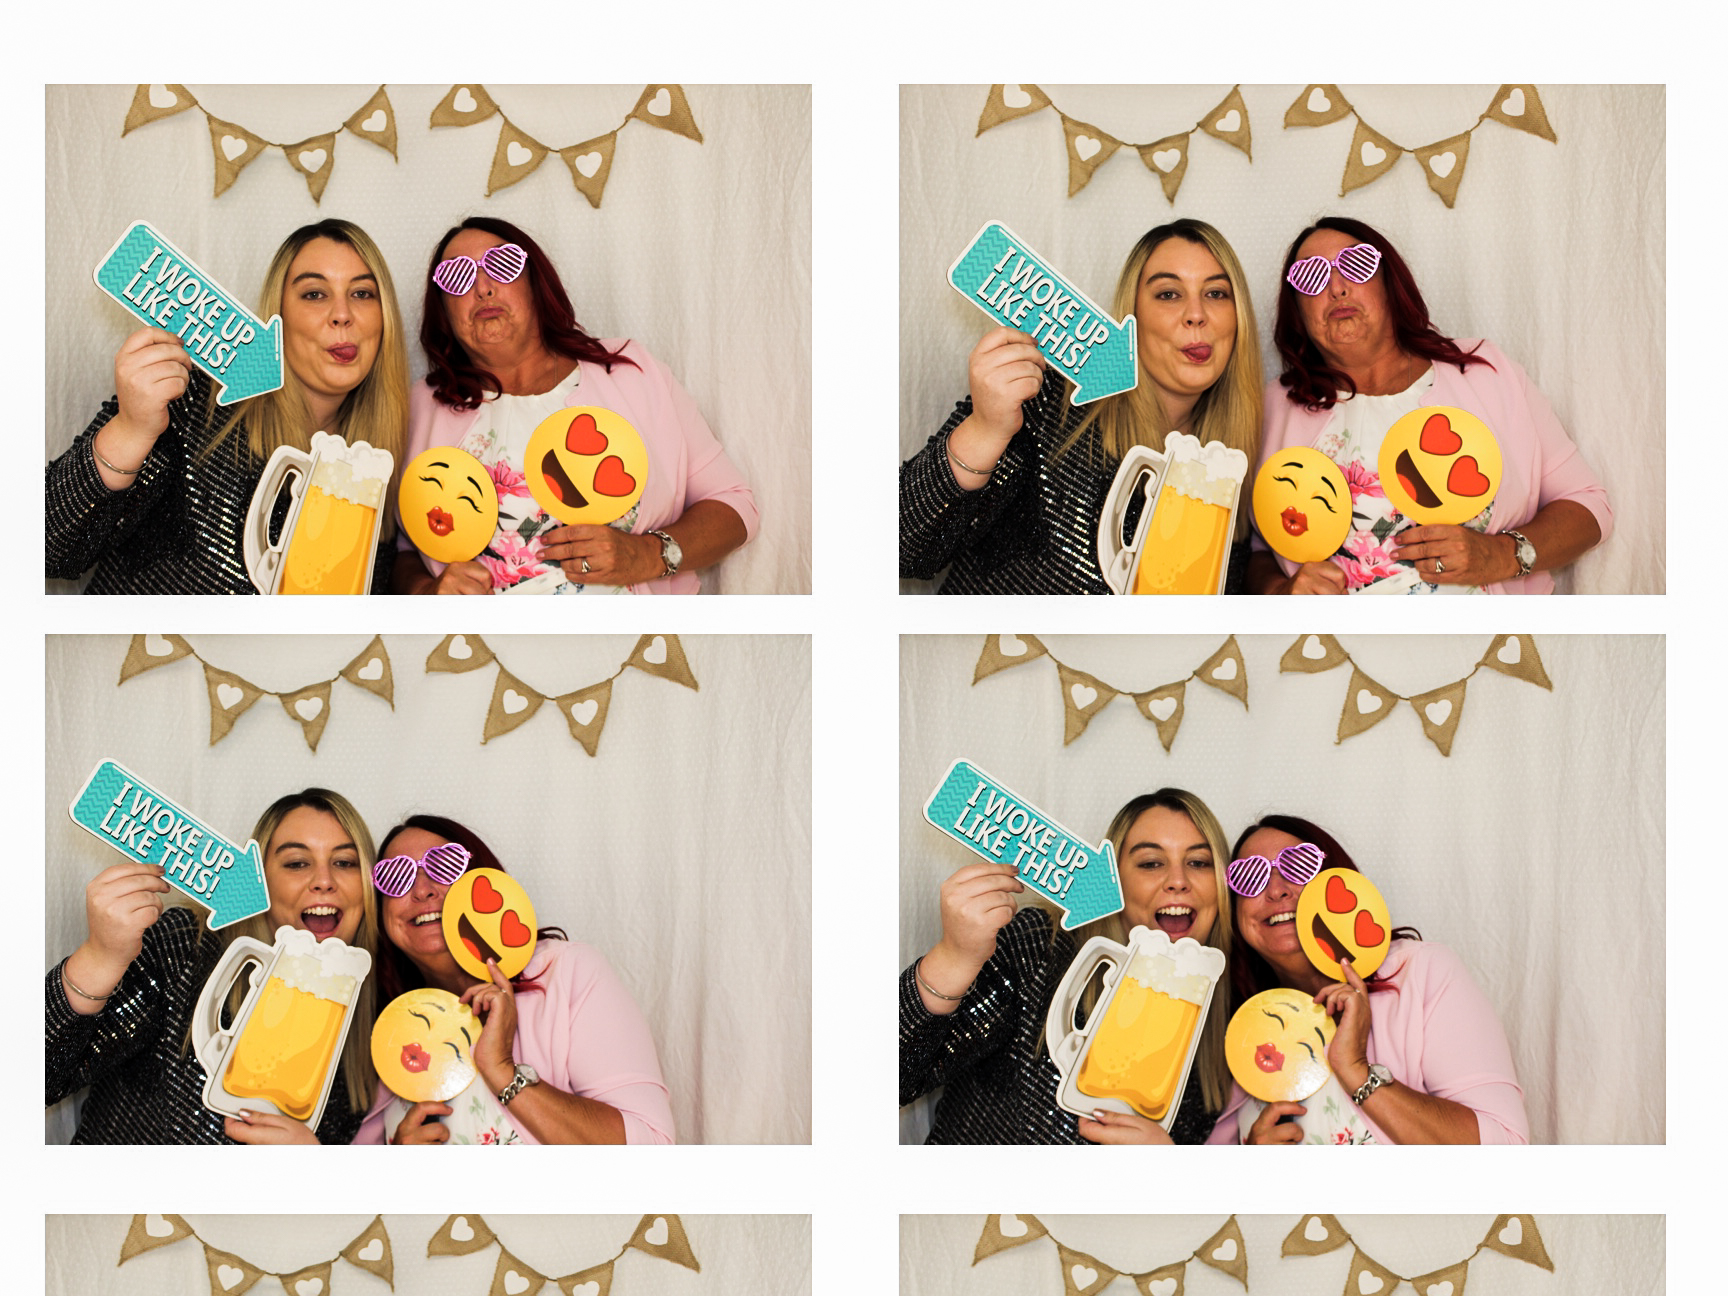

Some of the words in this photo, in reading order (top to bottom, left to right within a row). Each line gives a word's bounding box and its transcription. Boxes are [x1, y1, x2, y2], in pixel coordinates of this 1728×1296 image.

[122, 272, 180, 328] LIKE
[176, 312, 237, 374] THIS!
[140, 246, 162, 273] I
[155, 256, 227, 328] WOKE
[220, 312, 256, 348] UP
[976, 272, 1034, 328] LIKE
[1030, 312, 1091, 374] THIS!
[994, 246, 1016, 273] I
[1009, 256, 1081, 328] WOKE
[1074, 312, 1110, 348] UP
[100, 806, 157, 858] LIKE
[158, 842, 220, 899] THIS!
[113, 781, 133, 808] I
[129, 790, 203, 855] WOKE
[200, 839, 235, 873] UP
[954, 806, 1011, 858] LIKE
[1012, 842, 1074, 899] THIS!
[967, 781, 987, 808] I
[983, 790, 1057, 855] WOKE
[1054, 839, 1089, 873] UP
